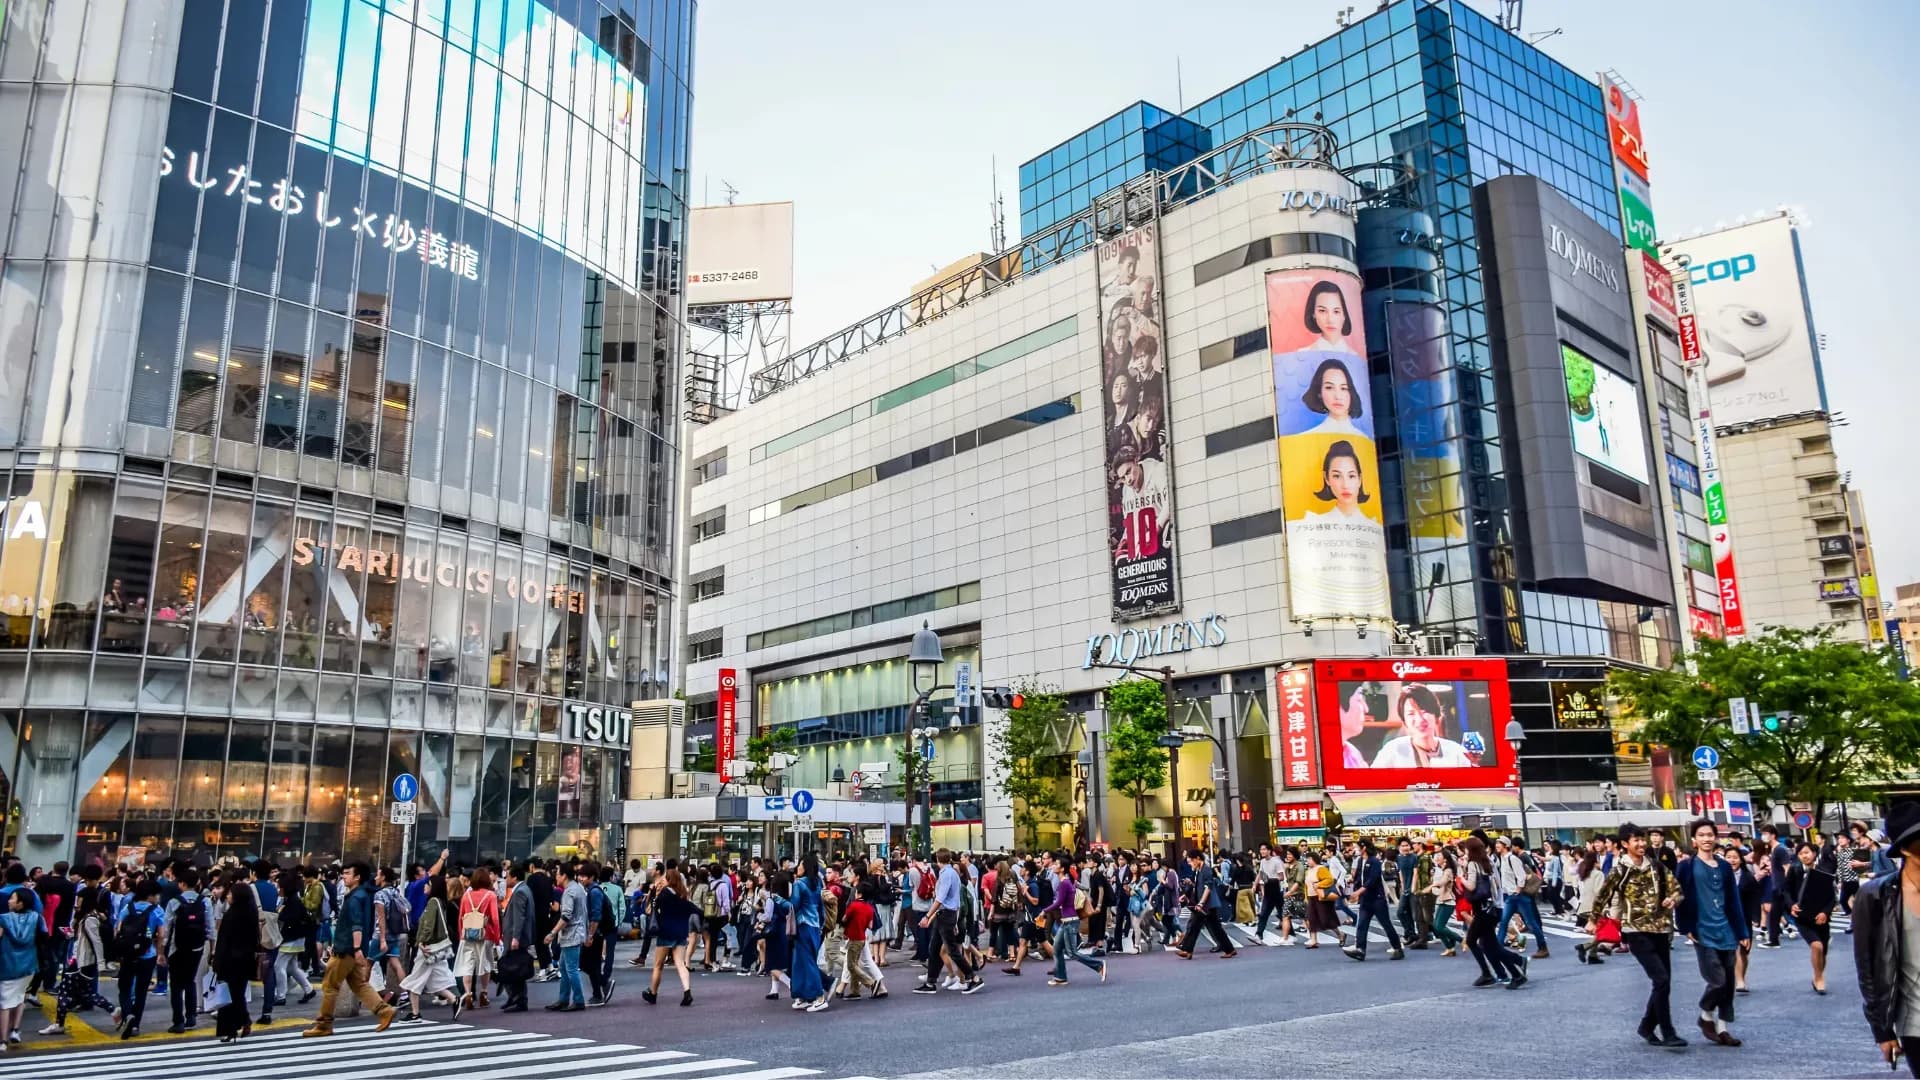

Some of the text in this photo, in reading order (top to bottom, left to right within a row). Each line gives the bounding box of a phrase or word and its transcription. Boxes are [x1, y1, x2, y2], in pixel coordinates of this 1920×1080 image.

[1618, 123, 1648, 169] アコム
[1626, 207, 1655, 247] レイク
[1549, 224, 1619, 293] 109MEN'S
[1683, 326, 1698, 360] アイフル
[1708, 490, 1723, 520] レイク
[1123, 507, 1159, 560] 10
[293, 537, 491, 594] STARBUCKS
[1118, 558, 1167, 579] GENERATIONS
[1119, 582, 1169, 604] 109MEN'S
[1720, 578, 1738, 611] アコム
[1081, 611, 1227, 680] 109MEN'S
[1392, 661, 1433, 679] Glico
[570, 704, 632, 744] TSUT
[1562, 710, 1598, 719] COFFEE
[1285, 687, 1311, 783] 天津甘栗
[117, 808, 275, 820] STARBUCKS COFFEE
[1278, 808, 1319, 821] 天津甘栗
